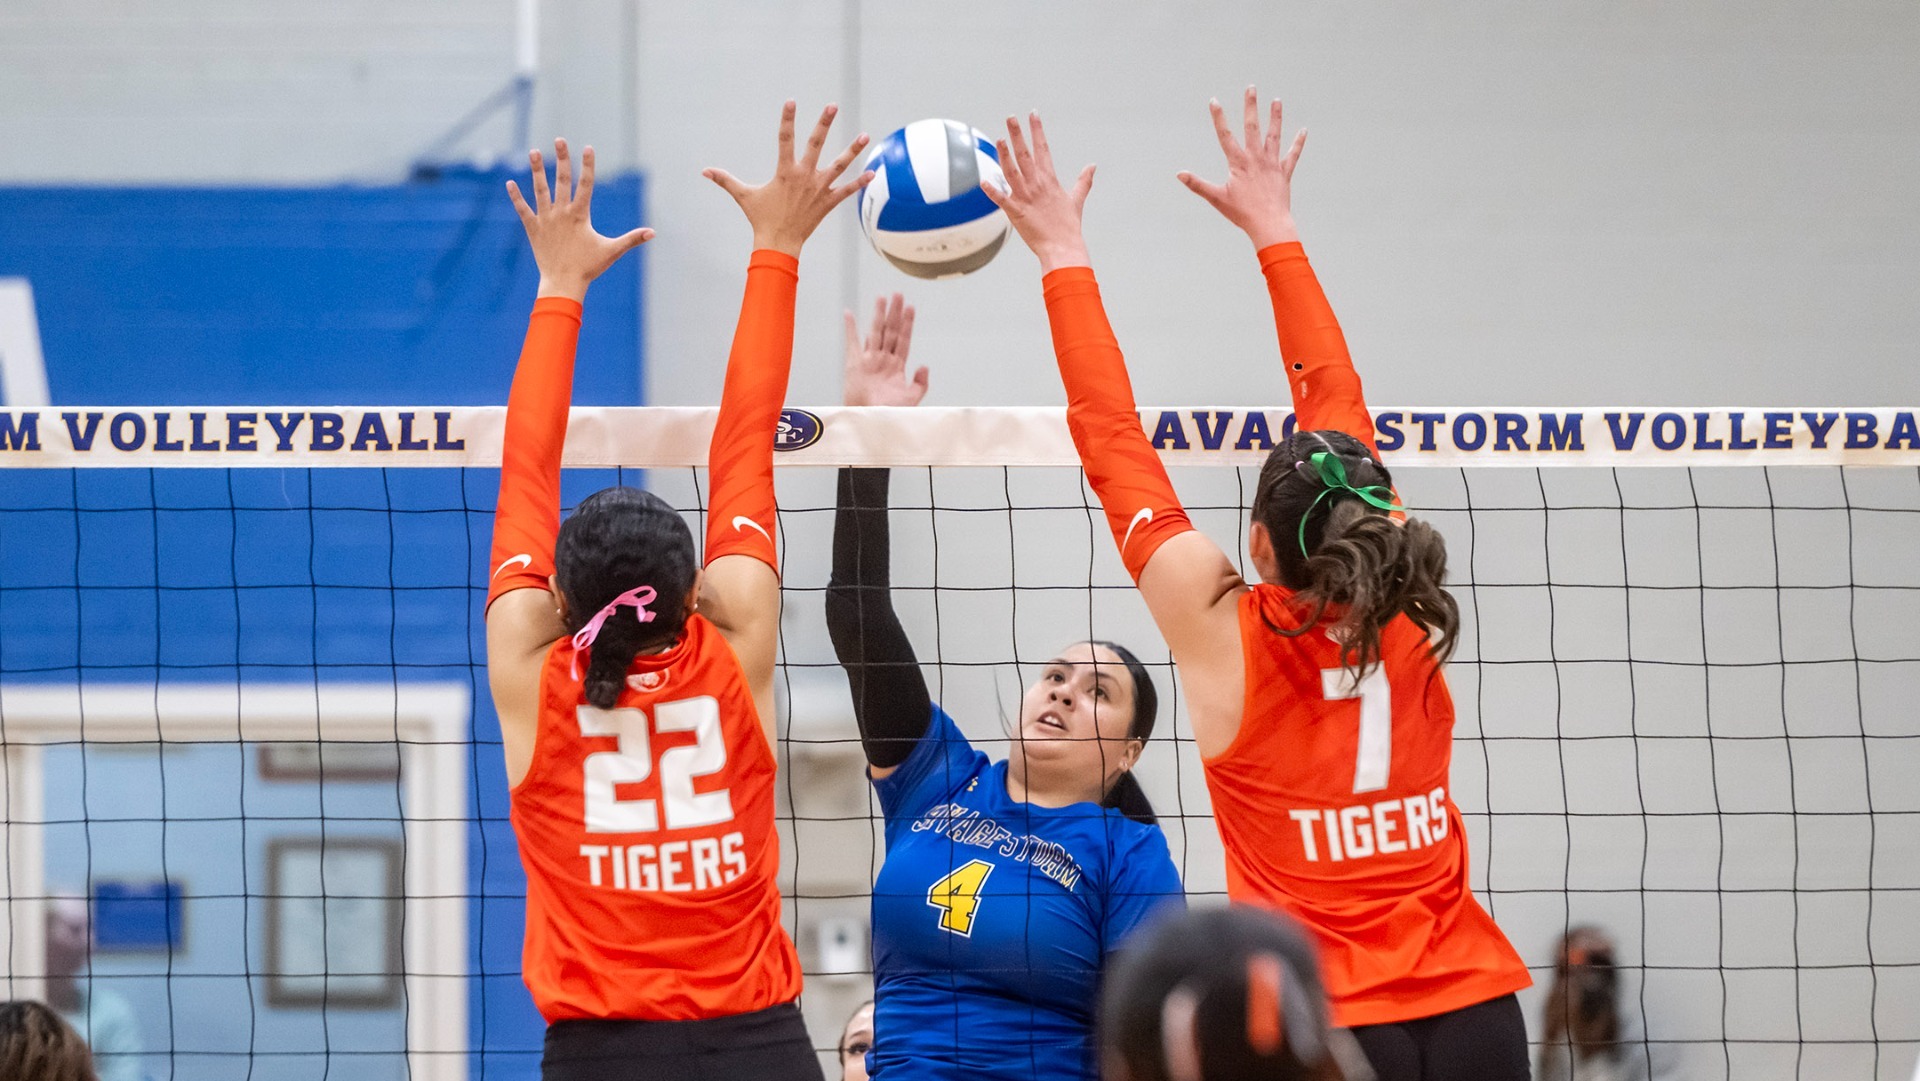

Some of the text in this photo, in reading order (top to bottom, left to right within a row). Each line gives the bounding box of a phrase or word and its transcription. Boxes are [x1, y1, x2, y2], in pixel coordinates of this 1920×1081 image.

[61, 412, 466, 451] VOLLEYBALL
[1374, 412, 1585, 451] STORM
[1604, 412, 1920, 451] VOLLEYBA
[576, 695, 735, 834] 22
[1320, 660, 1392, 794] 7
[579, 831, 748, 892] TIGERS
[1288, 786, 1448, 862] TIGERS
[926, 858, 995, 938] 4
